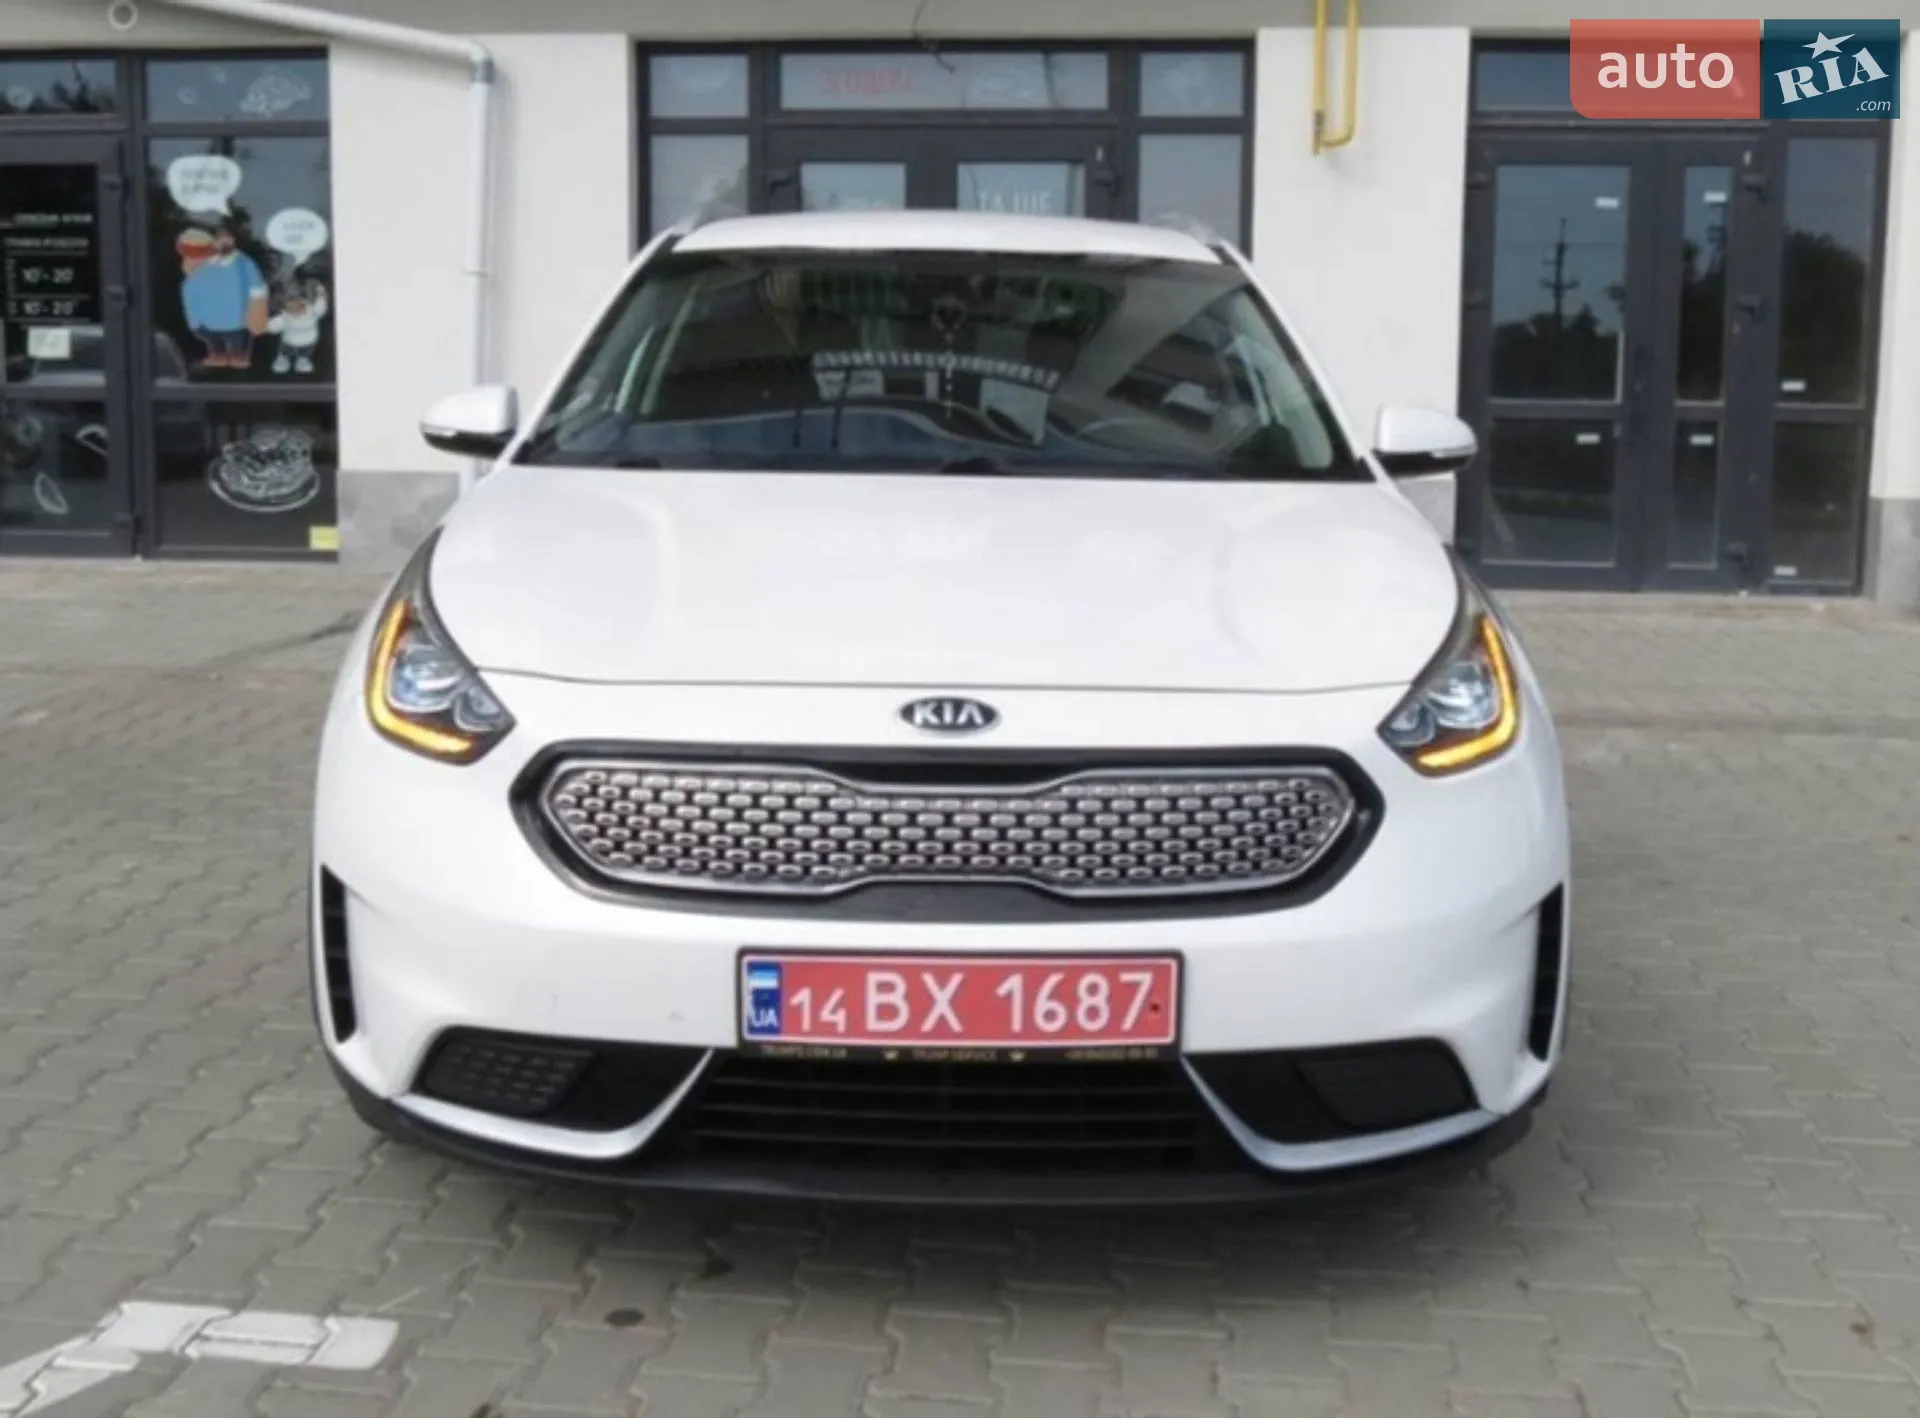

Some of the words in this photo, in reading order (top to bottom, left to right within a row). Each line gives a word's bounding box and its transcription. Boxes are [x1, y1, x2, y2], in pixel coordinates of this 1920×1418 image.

[913, 701, 985, 726] KIA
[788, 986, 847, 1034] 14
[865, 971, 965, 1034] BX
[995, 972, 1155, 1034] 1687
[752, 1007, 778, 1028] UA
